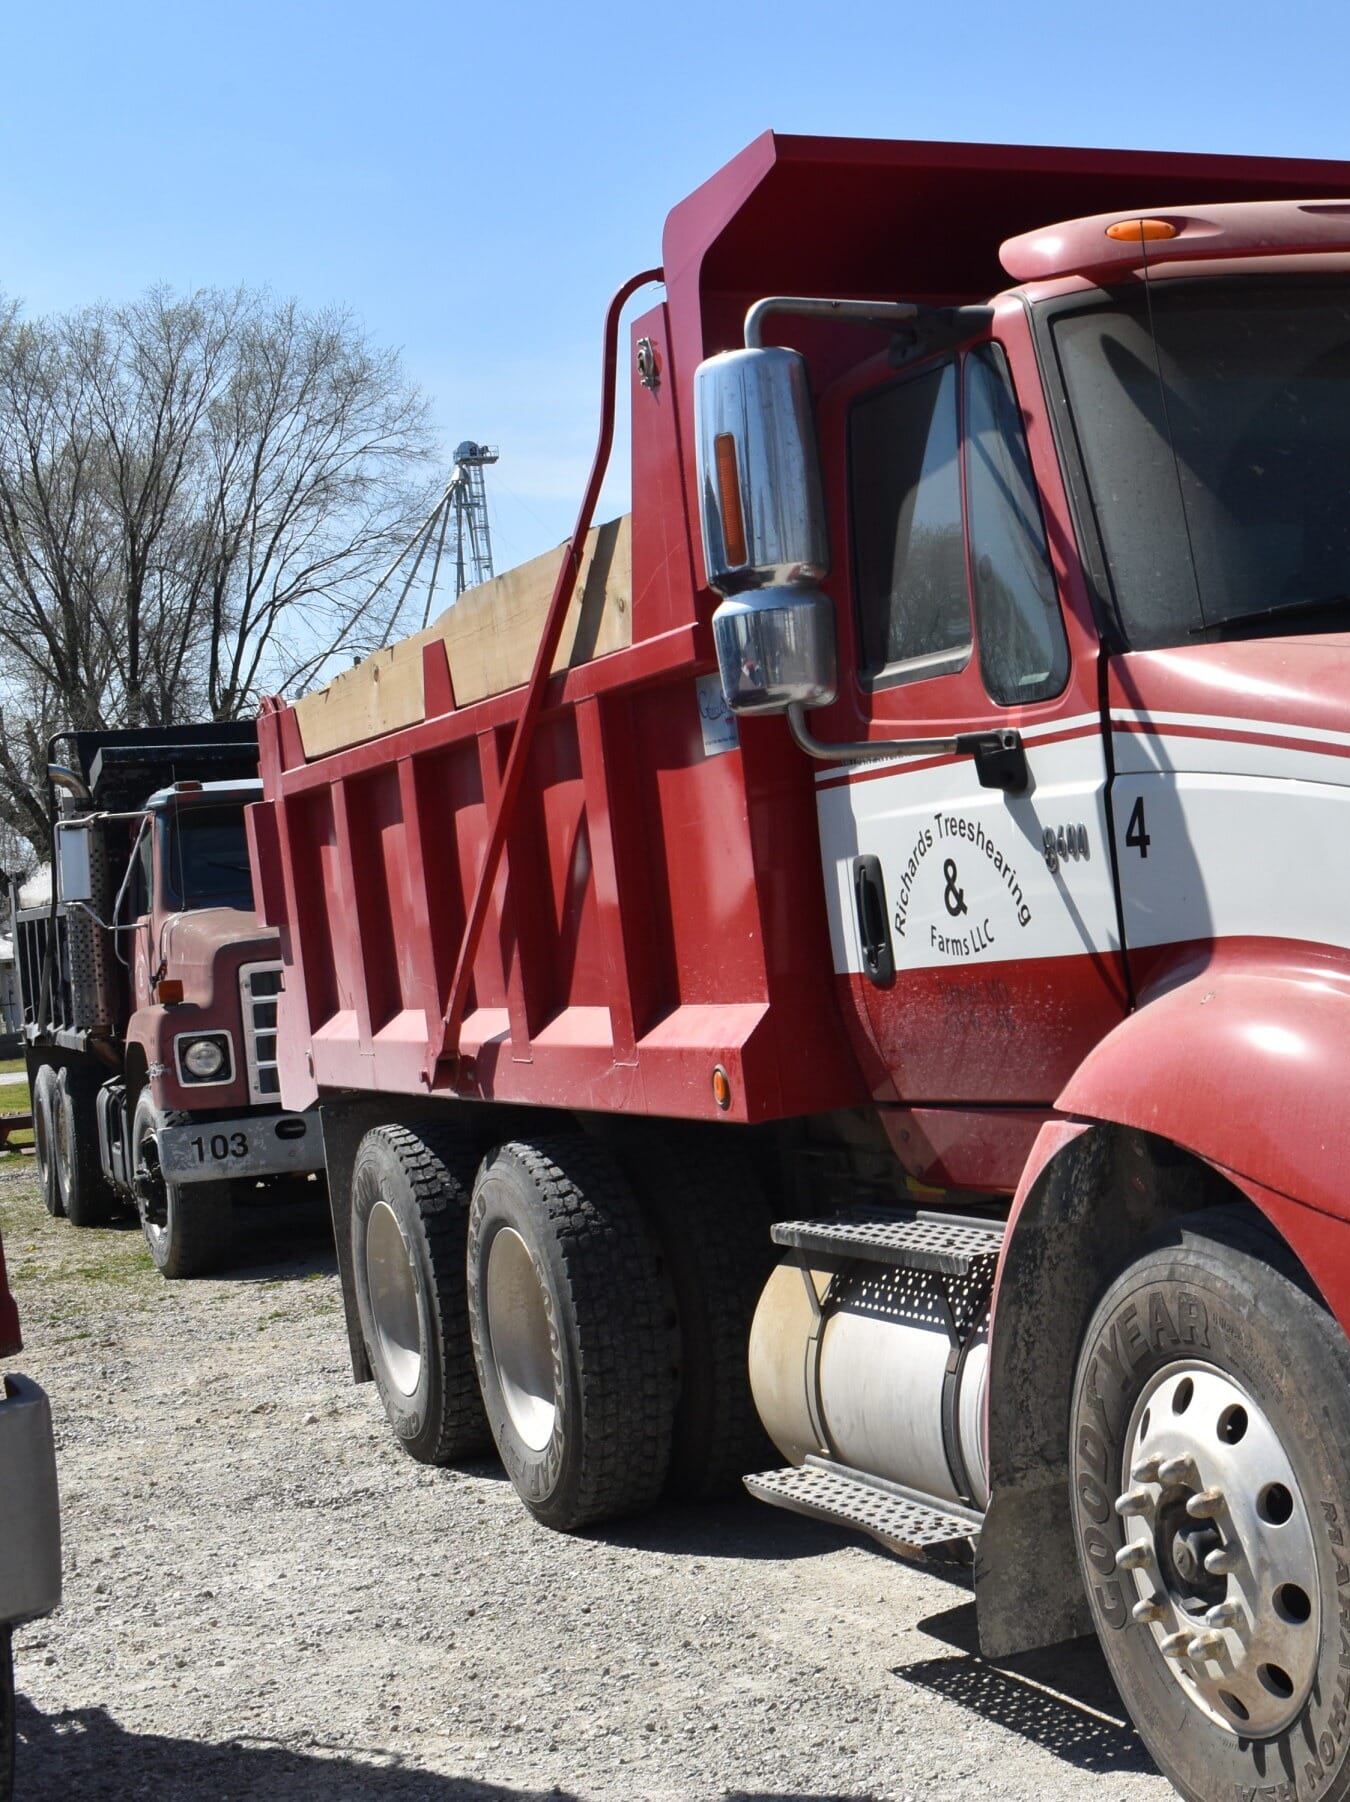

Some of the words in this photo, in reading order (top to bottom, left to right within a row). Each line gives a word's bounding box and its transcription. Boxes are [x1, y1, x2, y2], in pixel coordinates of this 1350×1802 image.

[1125, 796, 1151, 858] 4
[894, 828, 933, 937] Richards
[934, 812, 1032, 928] Treeshearing
[943, 858, 968, 918] &
[930, 925, 970, 956] Farms
[970, 918, 995, 953] LLC
[191, 1132, 249, 1163] 103
[1077, 1291, 1211, 1630] GOODYEAR
